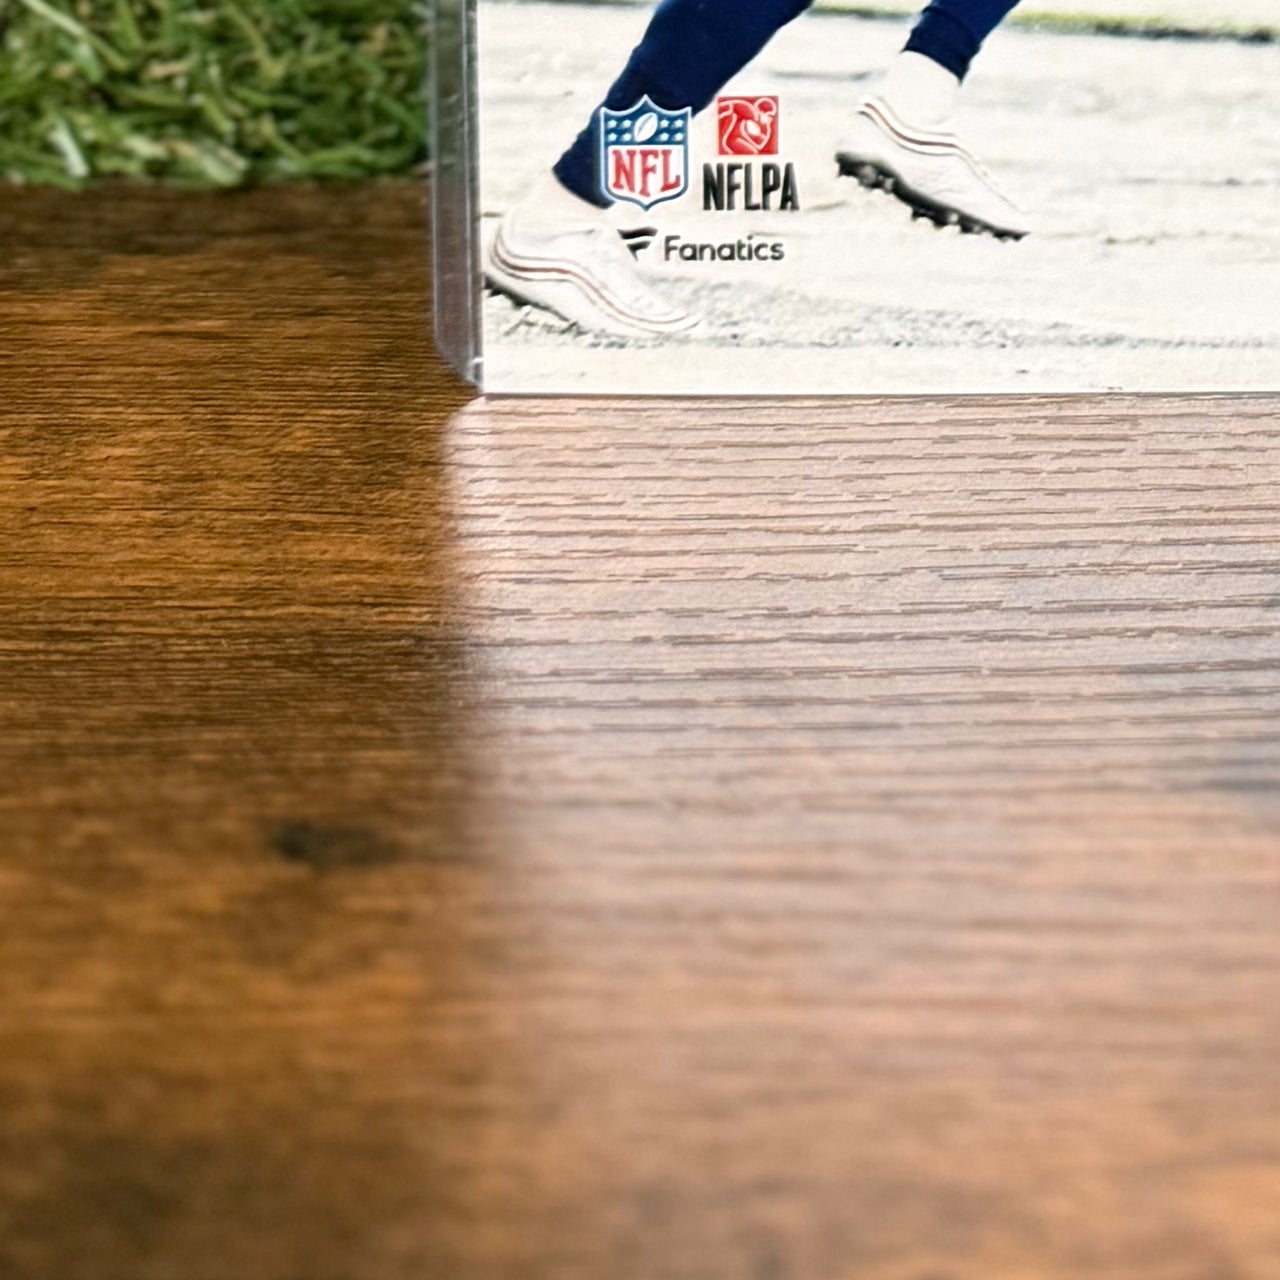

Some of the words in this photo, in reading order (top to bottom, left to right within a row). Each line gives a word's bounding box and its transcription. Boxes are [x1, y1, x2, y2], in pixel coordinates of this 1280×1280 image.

[612, 148, 682, 197] NFL
[703, 162, 800, 211] NFLPA
[664, 235, 785, 262] Fanatics
